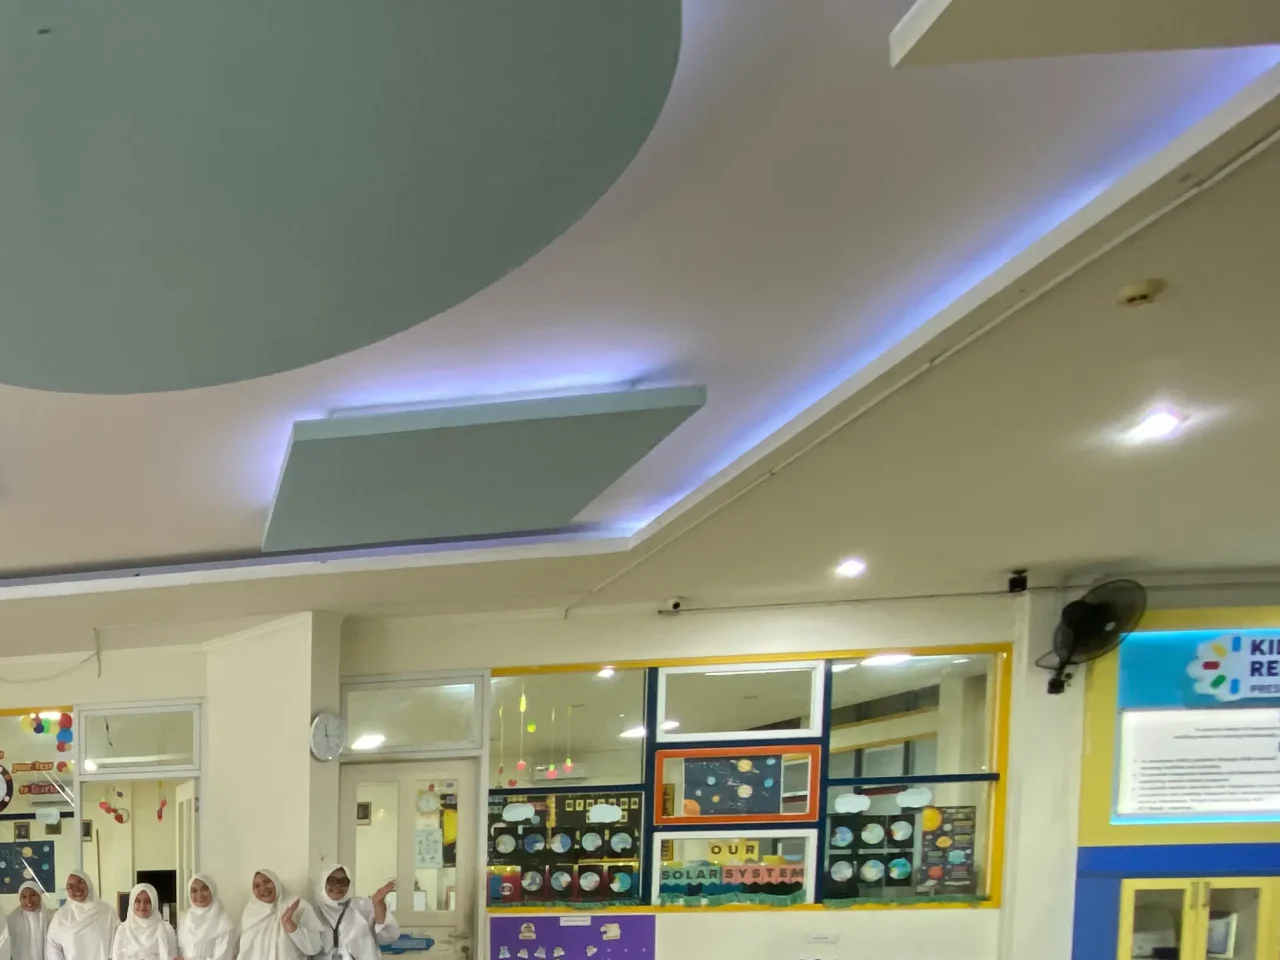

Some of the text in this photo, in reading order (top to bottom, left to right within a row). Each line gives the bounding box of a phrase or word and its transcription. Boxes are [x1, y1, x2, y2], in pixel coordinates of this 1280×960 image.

[1250, 639, 1280, 655] KI
[710, 844, 756, 855] OUR
[661, 867, 805, 880] SOLAR SYSTEM
